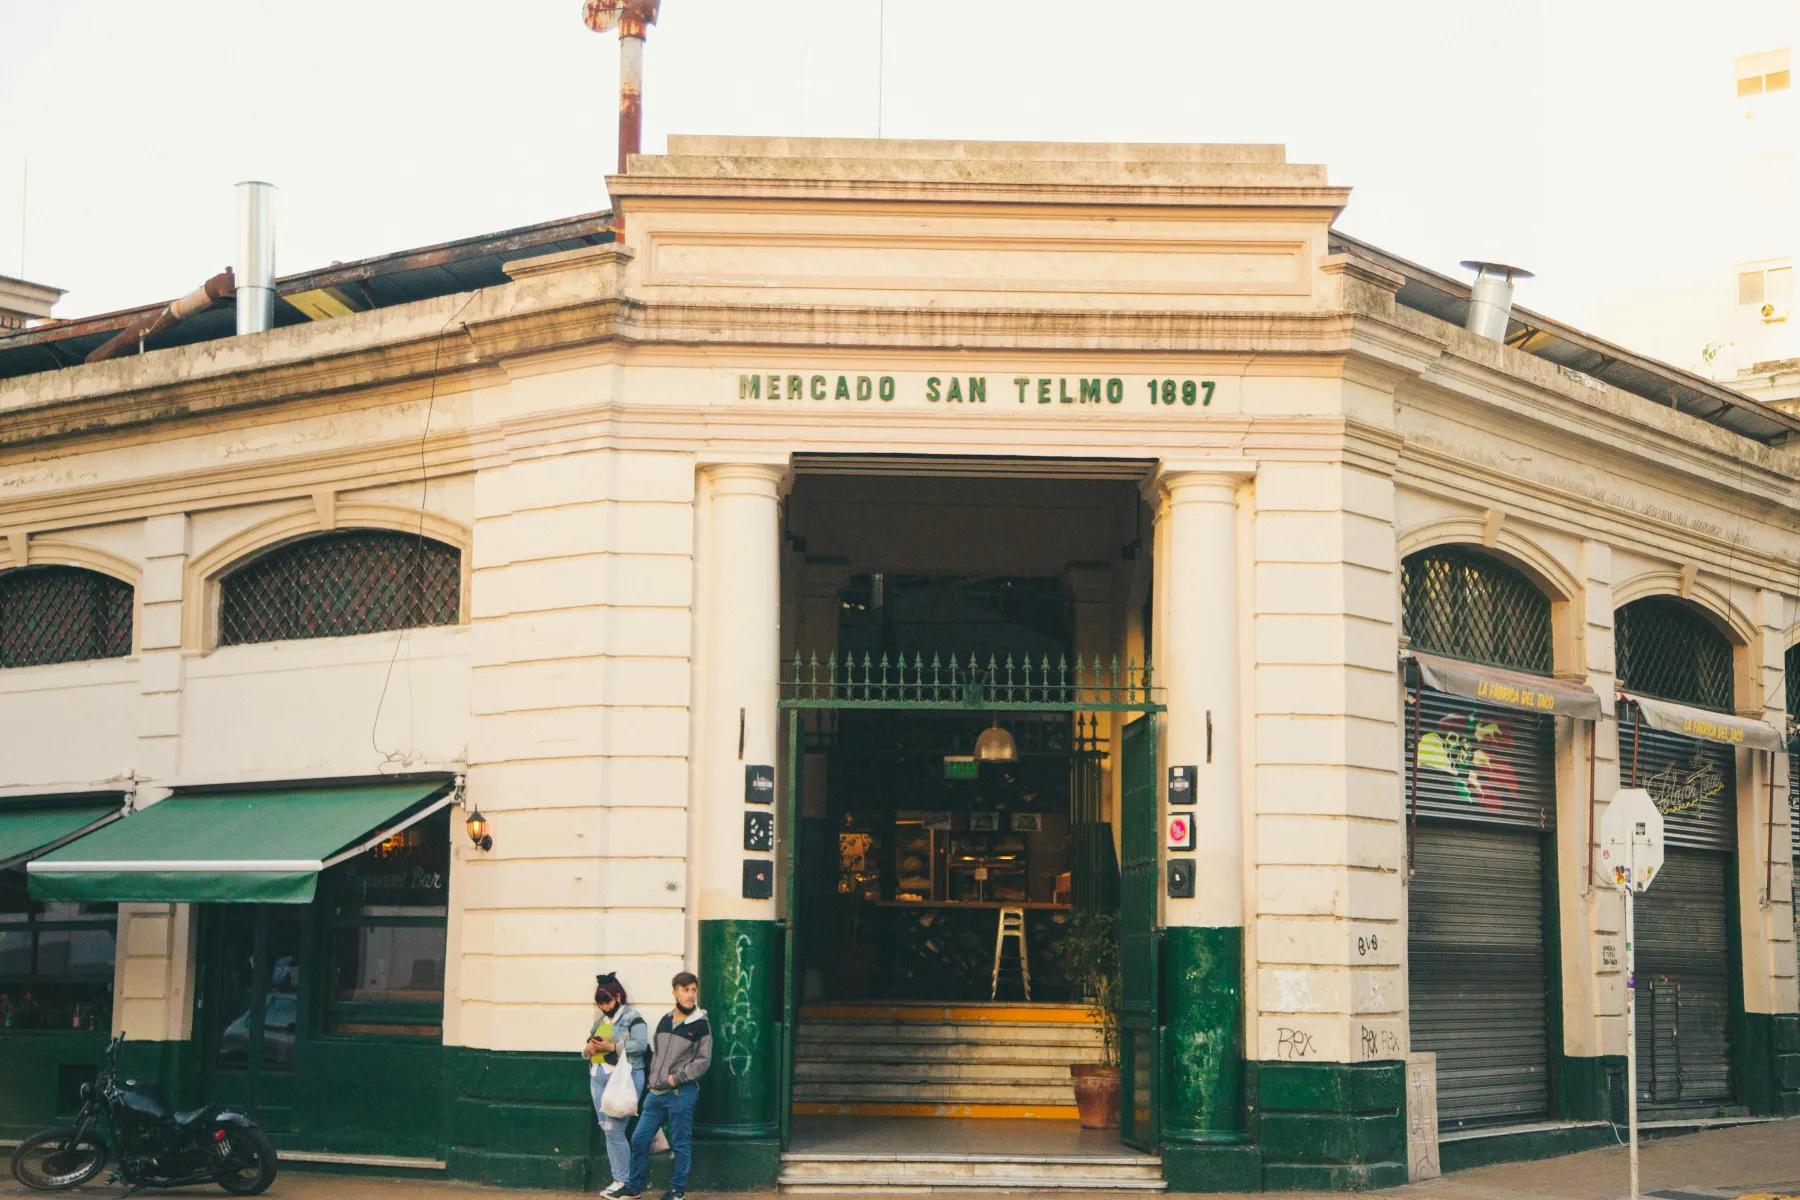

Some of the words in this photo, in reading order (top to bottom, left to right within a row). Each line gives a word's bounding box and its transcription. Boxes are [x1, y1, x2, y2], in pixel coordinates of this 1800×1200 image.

[739, 374, 895, 401] MERCADO
[926, 377, 986, 402] SAN
[1014, 378, 1123, 404] TELMO
[1147, 379, 1216, 406] 1897
[1478, 682, 1488, 697] LA
[1521, 690, 1535, 707] DEL
[1537, 692, 1555, 710] TACO
[1684, 719, 1692, 732] LA
[1717, 724, 1728, 740] DEL
[410, 865, 442, 890] Bar
[1277, 1026, 1317, 1059] Rex
[1361, 1024, 1379, 1058] Rex
